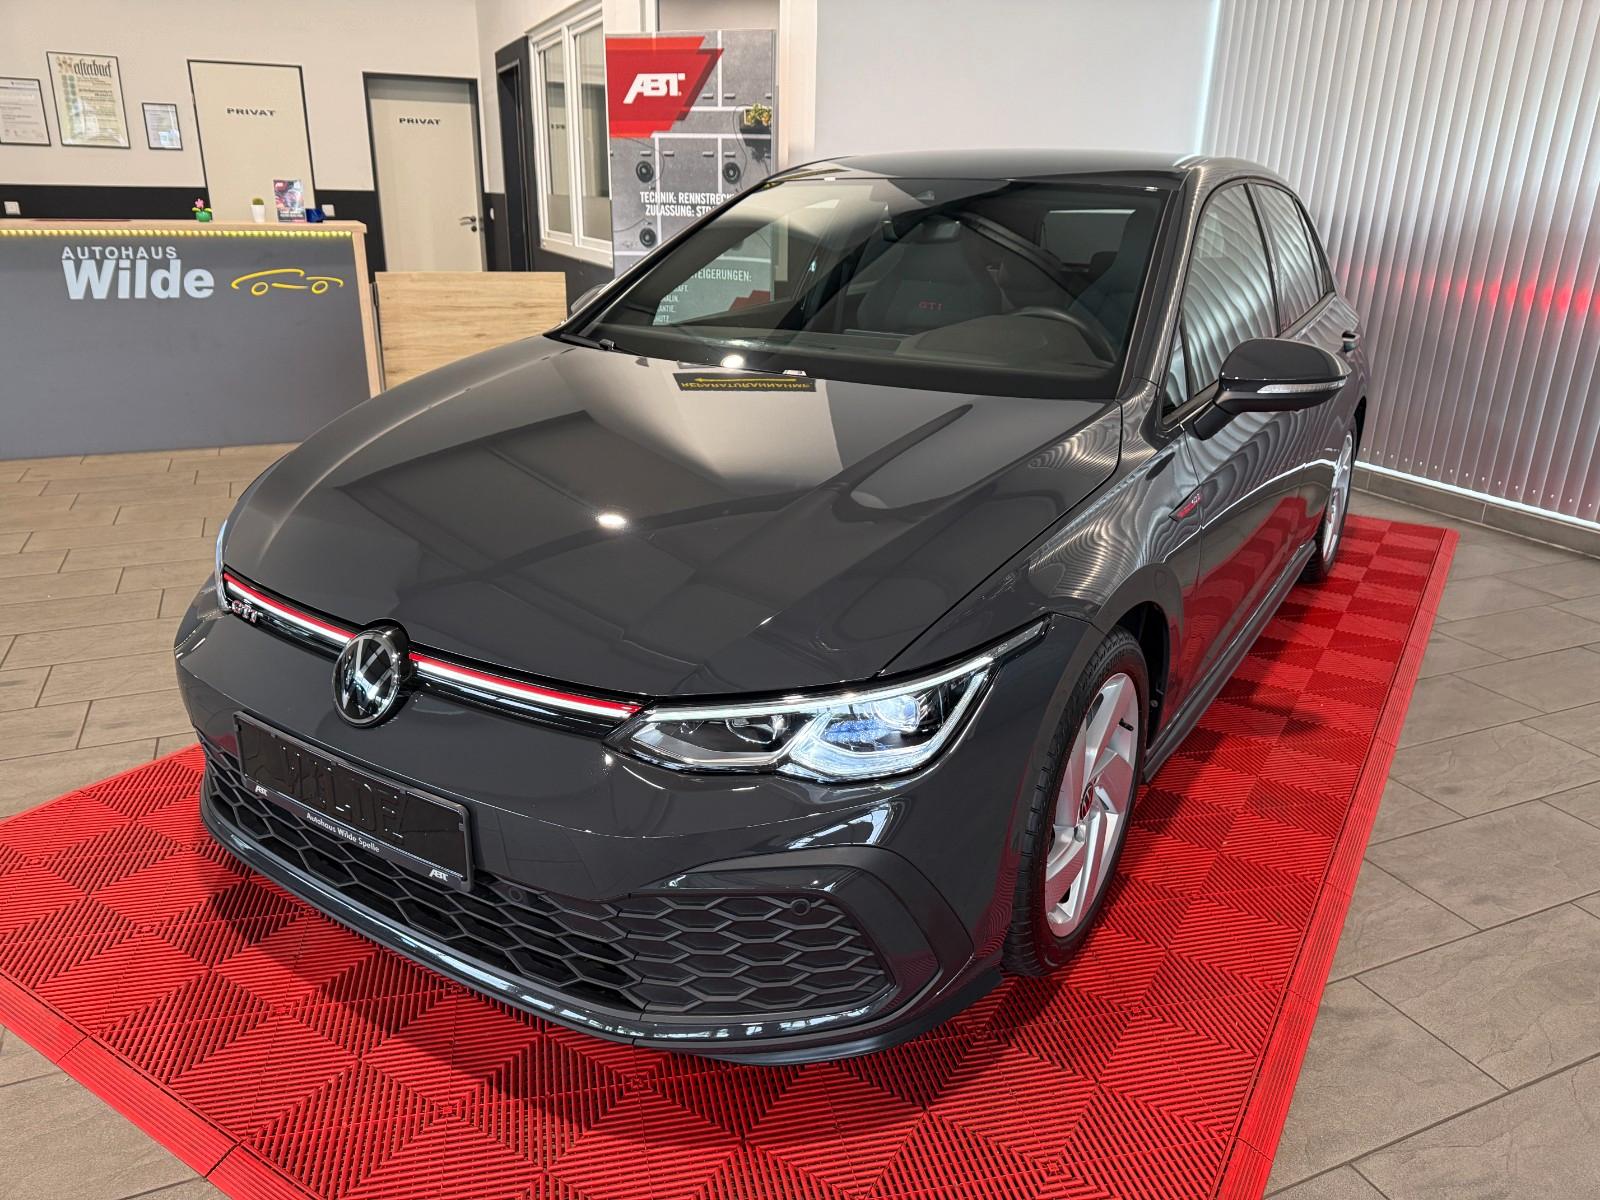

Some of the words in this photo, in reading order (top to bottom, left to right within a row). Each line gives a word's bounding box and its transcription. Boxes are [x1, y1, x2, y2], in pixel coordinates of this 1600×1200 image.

[623, 73, 686, 104] ABT
[226, 107, 276, 117] PRIVAT
[399, 117, 441, 125] PRIVAT
[640, 192, 676, 204] TECHNIK:
[678, 192, 734, 206] RENNSTREC
[645, 204, 695, 217] ZULASSUNG:
[61, 246, 178, 260] AUTOHAUS
[61, 259, 215, 300] Wilde
[918, 301, 944, 311] GTI
[306, 812, 337, 833] Autohaus
[336, 827, 357, 843] Wilde
[358, 837, 380, 853] Spelle
[429, 869, 449, 882] ABT
